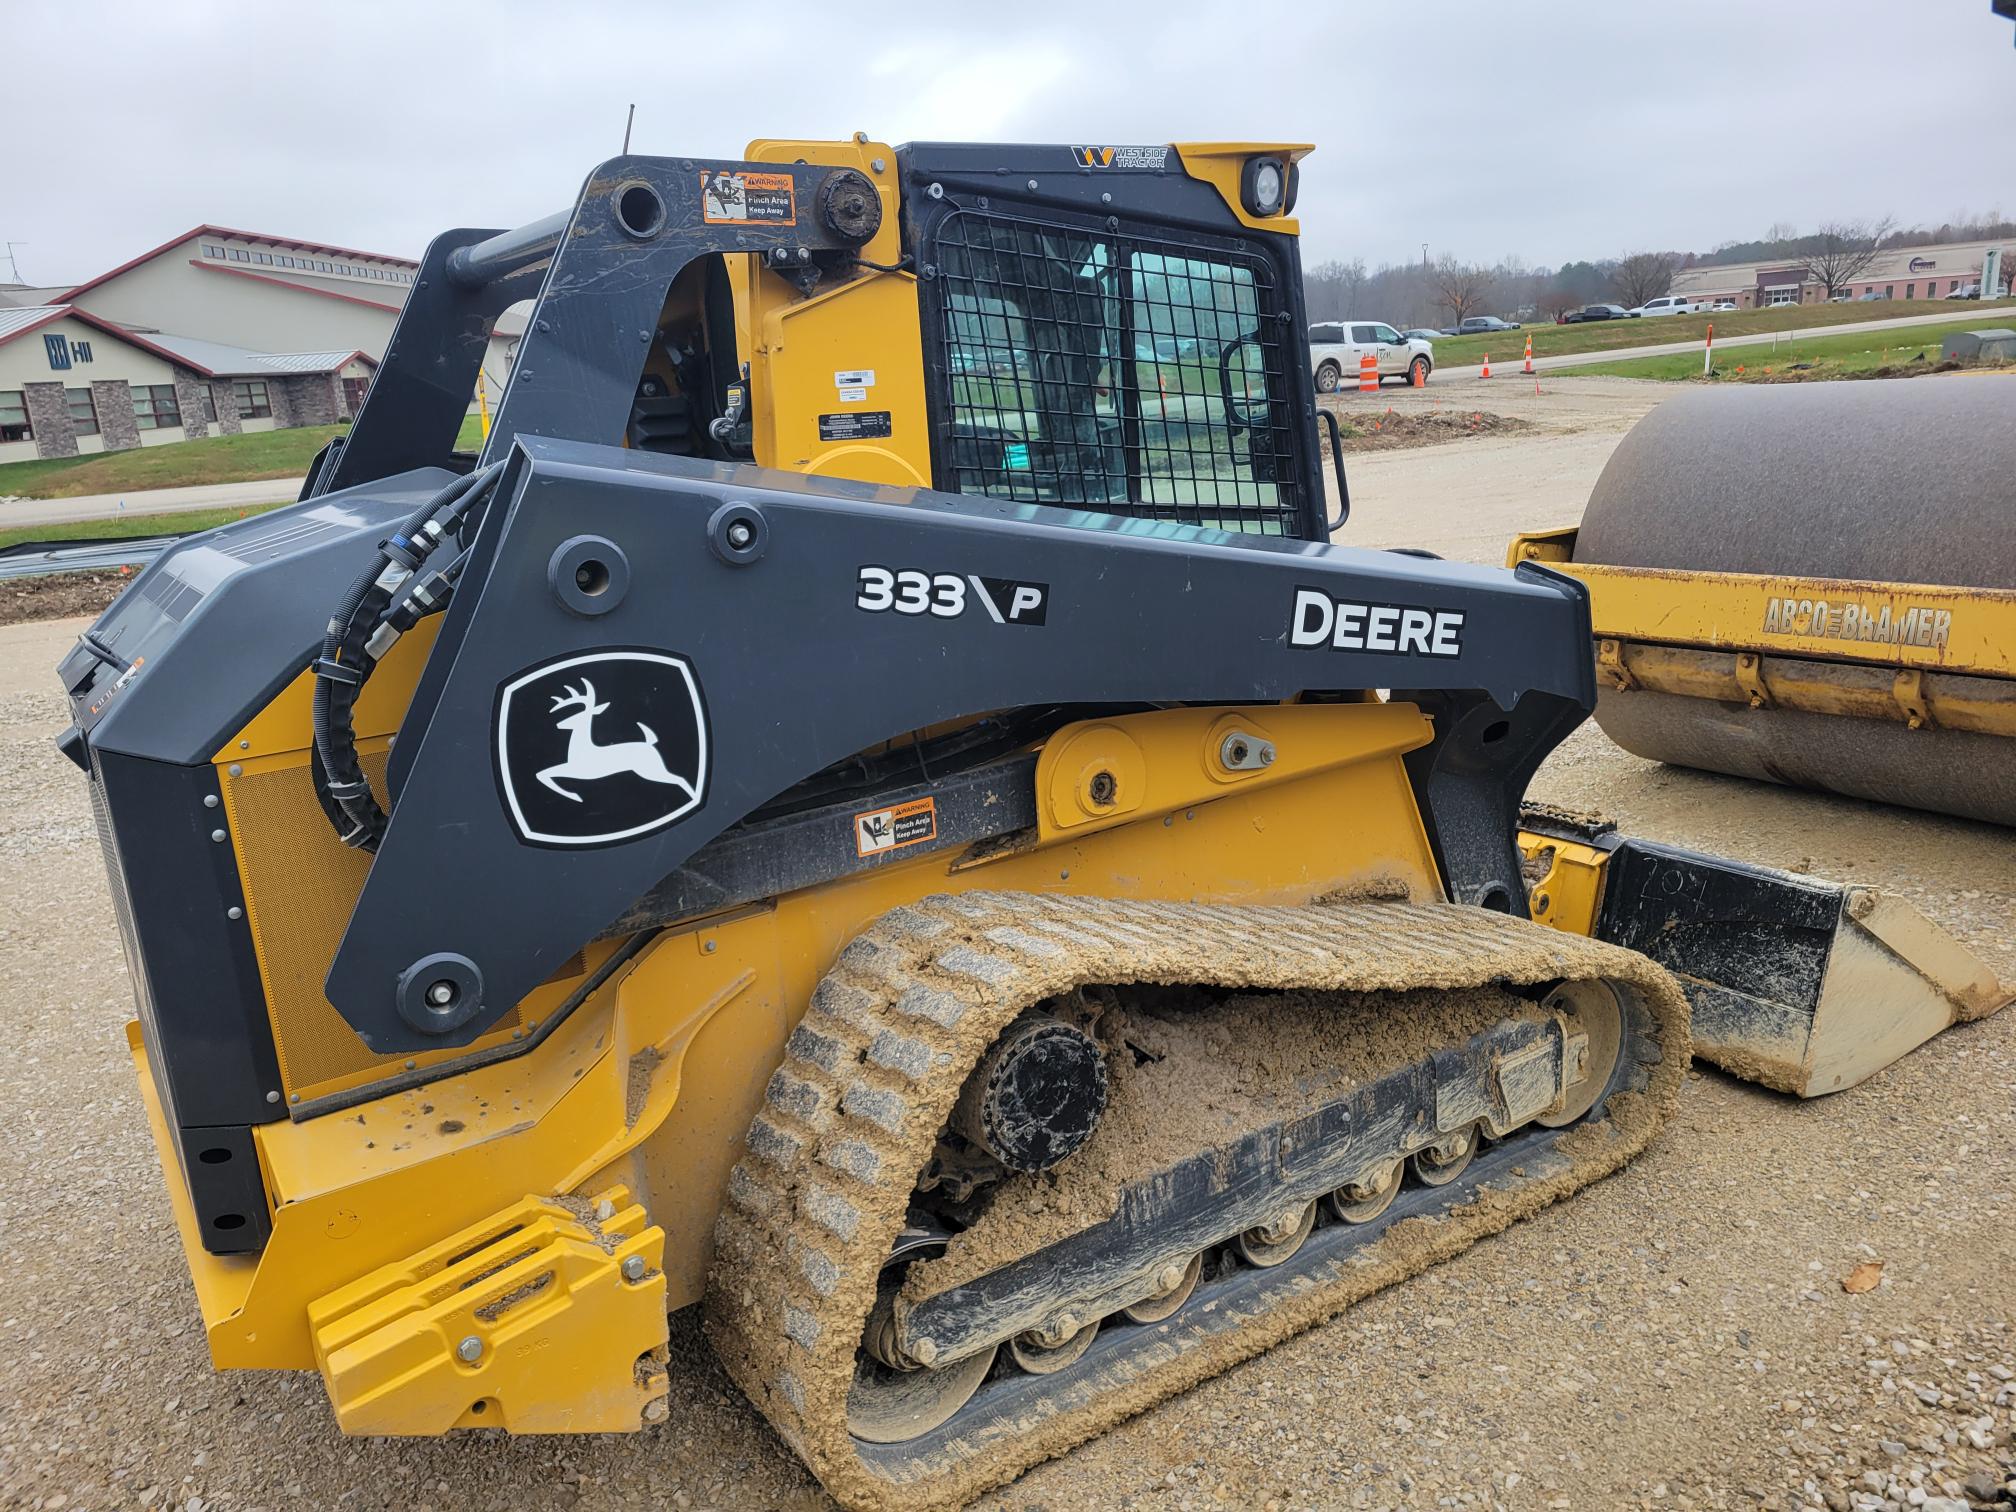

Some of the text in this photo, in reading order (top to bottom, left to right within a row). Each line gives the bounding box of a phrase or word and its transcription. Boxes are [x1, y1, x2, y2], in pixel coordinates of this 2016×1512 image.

[1115, 147, 1168, 158] WEST SIDE
[1116, 157, 1165, 168] TRACTOR
[753, 178, 789, 188] WARNING
[771, 196, 789, 205] Area
[748, 206, 784, 216] Keep Away
[857, 566, 967, 617] 333
[1291, 590, 1464, 656] DEERE
[901, 802, 931, 815] WARNING
[895, 817, 931, 832] Pinch Area
[896, 827, 927, 840] Keep Away
